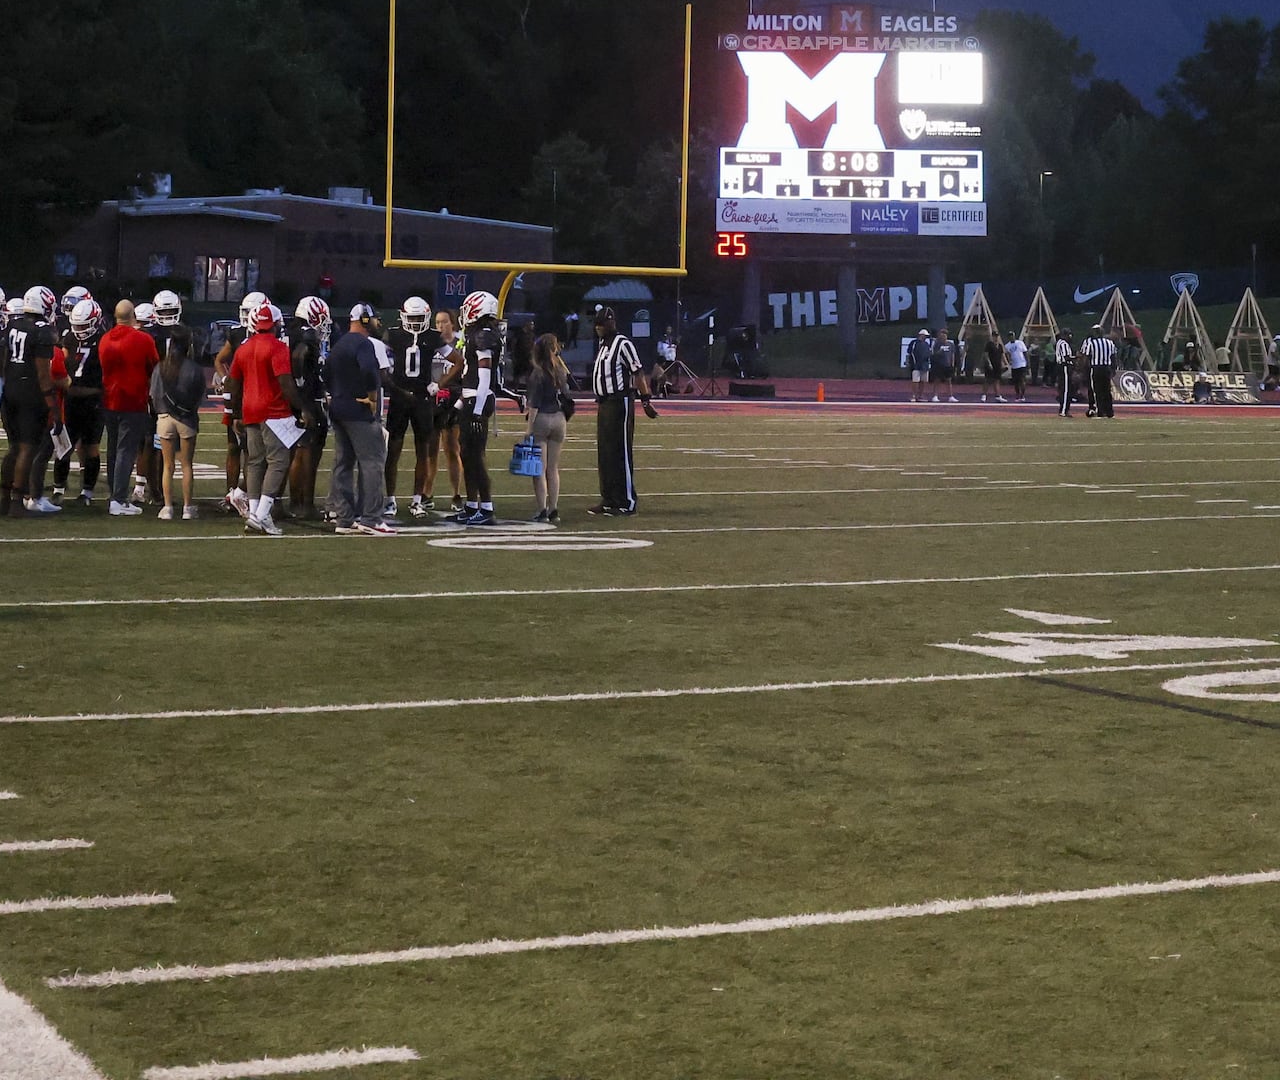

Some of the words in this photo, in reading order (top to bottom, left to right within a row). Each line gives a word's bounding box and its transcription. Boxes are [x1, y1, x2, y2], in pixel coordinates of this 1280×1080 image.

[747, 15, 822, 31] MILTON
[881, 16, 957, 32] EAGLES
[743, 36, 869, 51] CRABAPPLE
[873, 37, 960, 51] MARKET
[736, 51, 887, 149] M
[822, 152, 879, 173] 8:08
[747, 171, 758, 187] 7
[943, 174, 954, 189] 0
[721, 201, 778, 225] Chick-fil-A
[861, 205, 909, 221] NALLEY
[941, 210, 984, 222] CERTIFIED
[718, 234, 746, 255] 25
[445, 273, 467, 295] M
[768, 291, 838, 328] THE
[405, 347, 420, 377] 0
[1148, 374, 1247, 388] CRABPPLE
